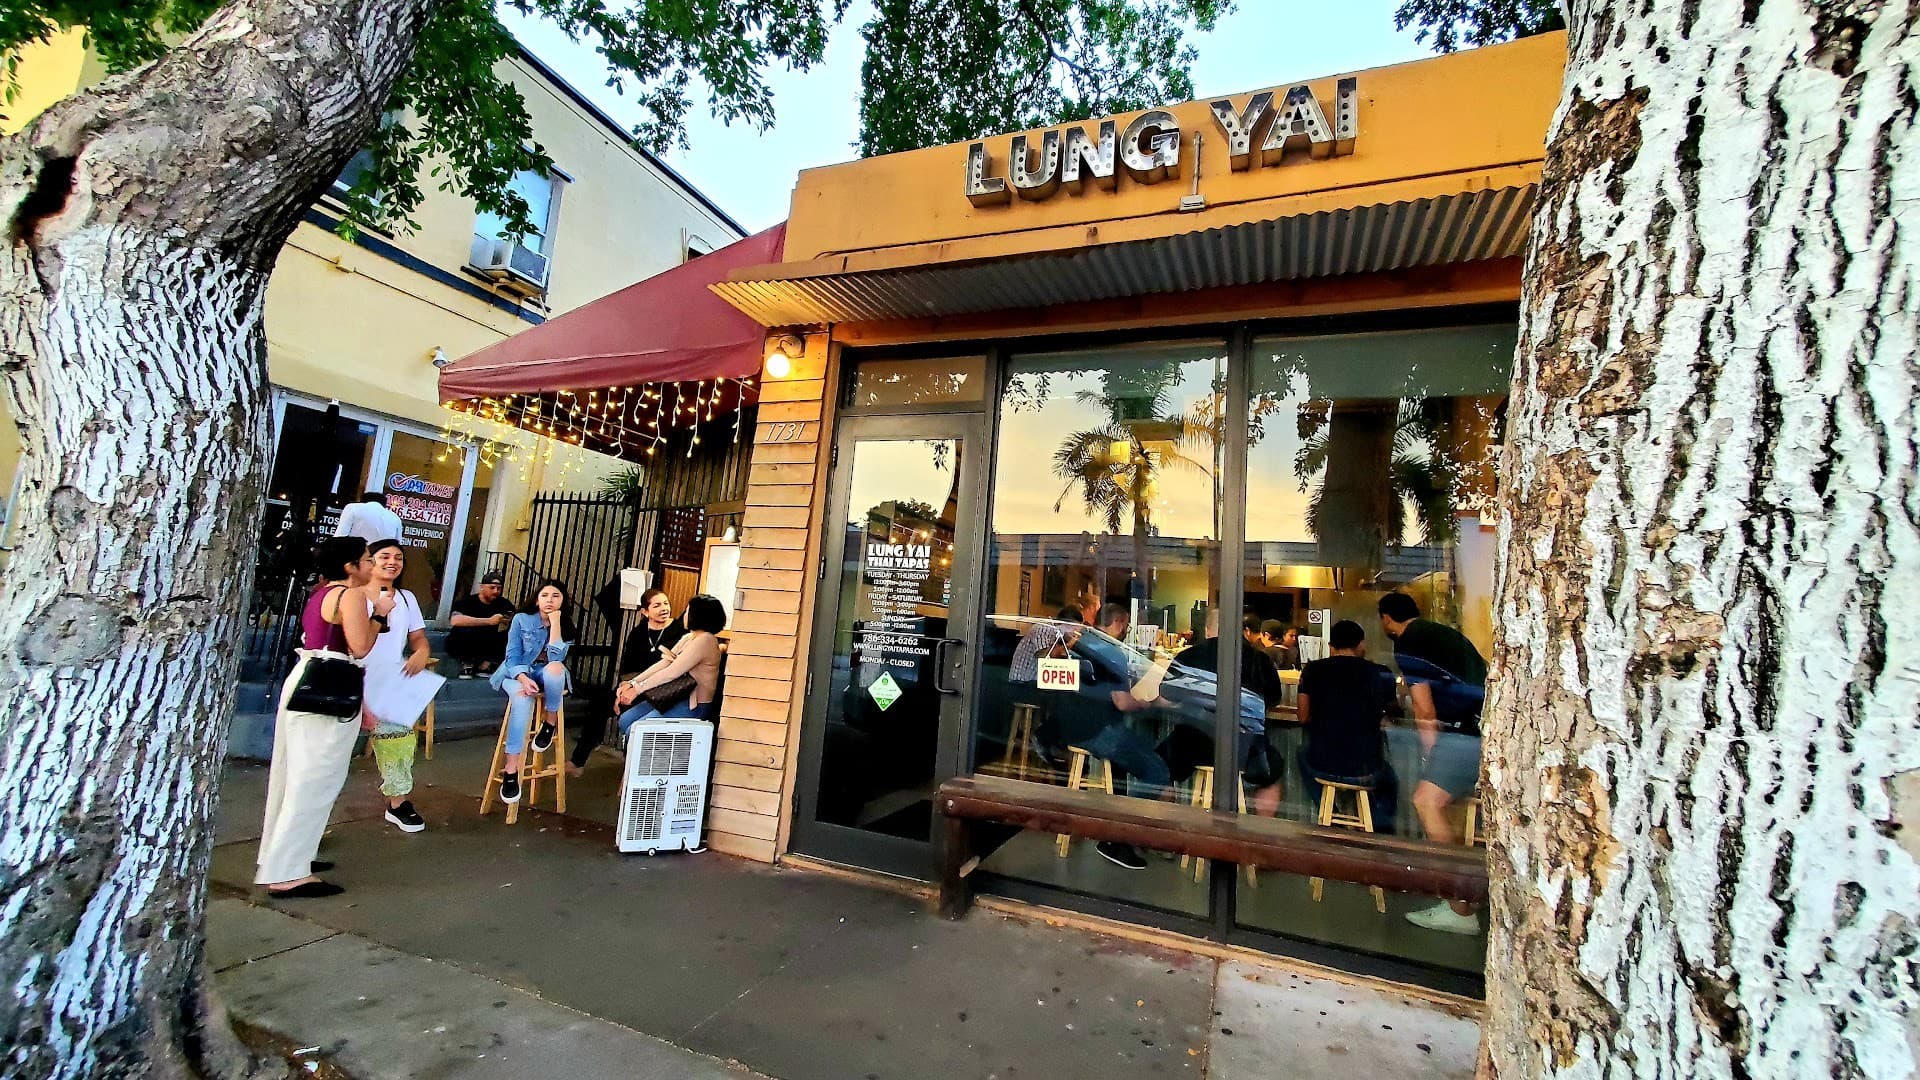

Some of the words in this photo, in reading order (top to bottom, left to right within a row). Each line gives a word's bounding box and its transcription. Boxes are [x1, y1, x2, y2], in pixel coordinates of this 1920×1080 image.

[966, 109, 1181, 204] LUNG
[1210, 77, 1358, 170] YAI
[766, 422, 805, 441] 1731
[404, 526, 444, 540] BIENVENIDO
[413, 538, 428, 548] CITA
[868, 543, 904, 557] LUNG
[906, 543, 931, 558] YAI
[867, 556, 894, 567] THAI
[895, 557, 930, 569] TAPAS
[867, 571, 892, 579] TUESDAY
[896, 572, 930, 580] THURSDAY
[863, 634, 918, 646] 786-334-6262
[859, 656, 886, 664] MONDAY
[890, 659, 915, 667] CLOSED
[1042, 669, 1075, 685] OPEN
